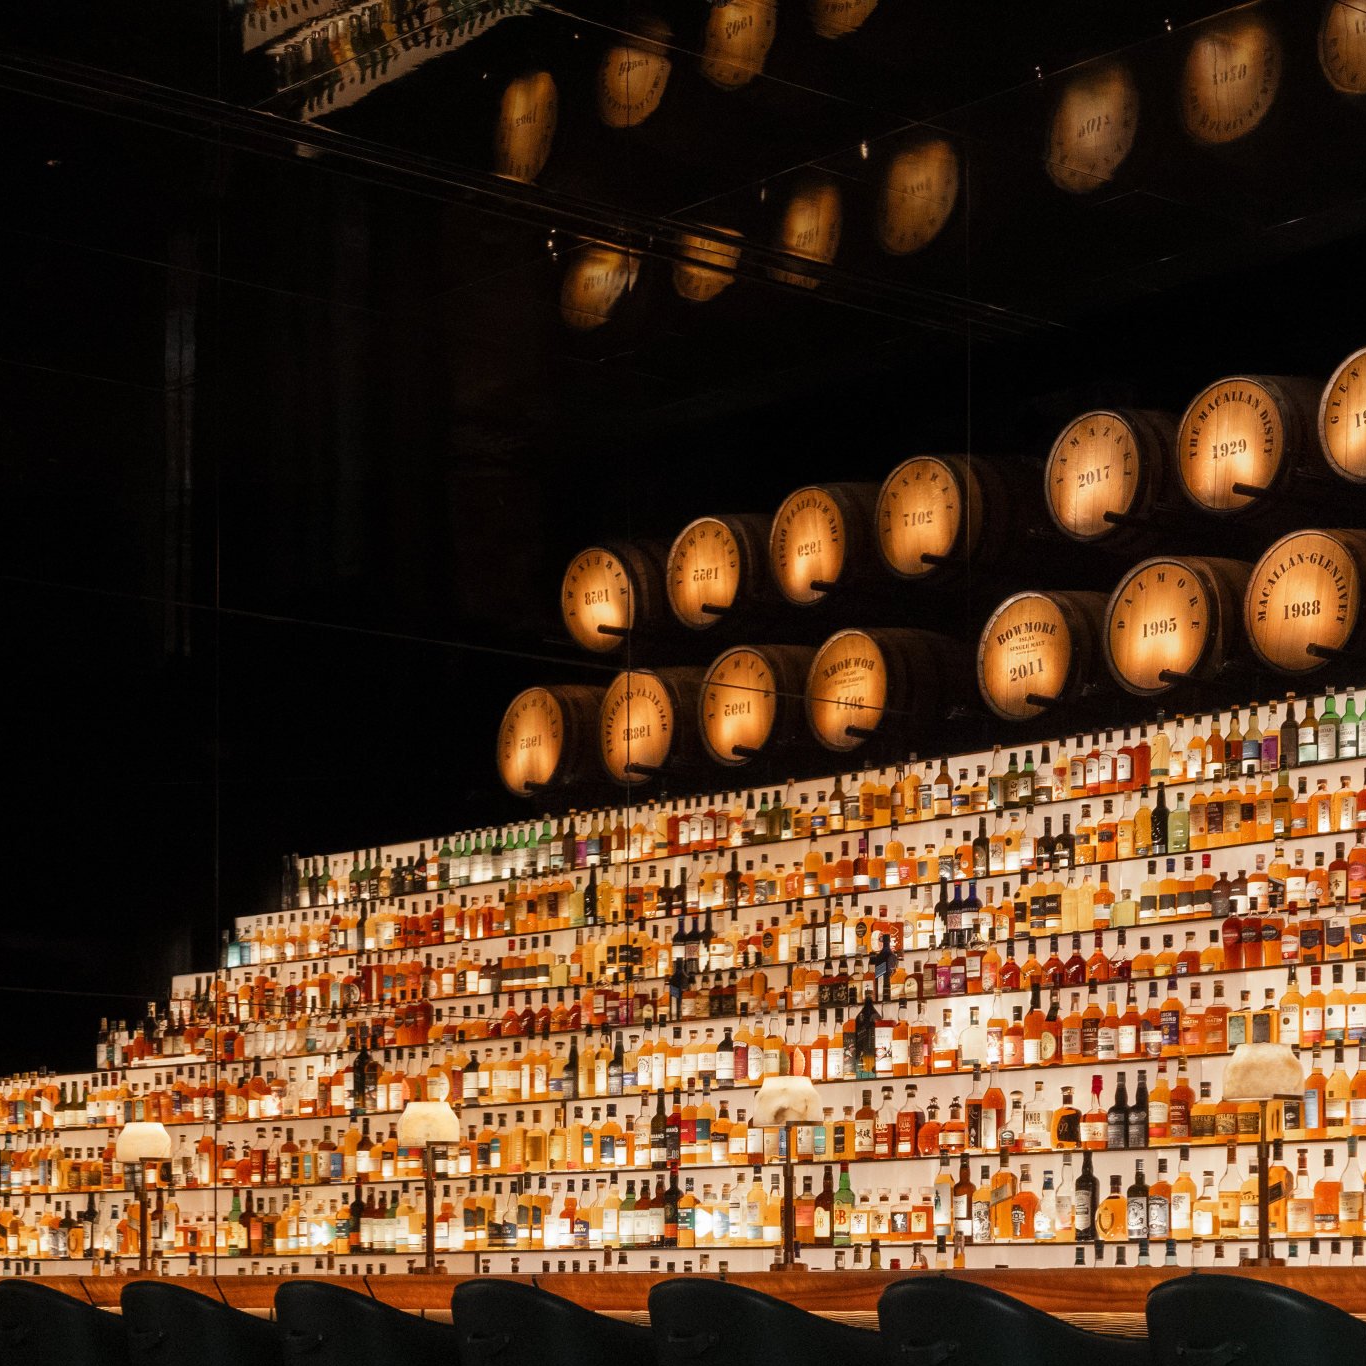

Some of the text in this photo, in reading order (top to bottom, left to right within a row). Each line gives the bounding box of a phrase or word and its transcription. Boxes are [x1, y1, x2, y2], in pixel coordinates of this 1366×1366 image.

[1330, 367, 1360, 425] GLEN
[1189, 390, 1274, 459] THE MACALLAN DISTY
[1056, 426, 1132, 484] YAMAZAKI
[1212, 438, 1247, 459] 1929
[1078, 465, 1110, 488] 2017
[1117, 572, 1200, 630] DALMORE
[1257, 552, 1349, 625] MACALLAN-GLENLIVET
[1283, 600, 1321, 620] 1988
[996, 621, 1058, 646] BOWMORE
[1143, 617, 1177, 638] 1995
[1009, 657, 1044, 682] 2011
